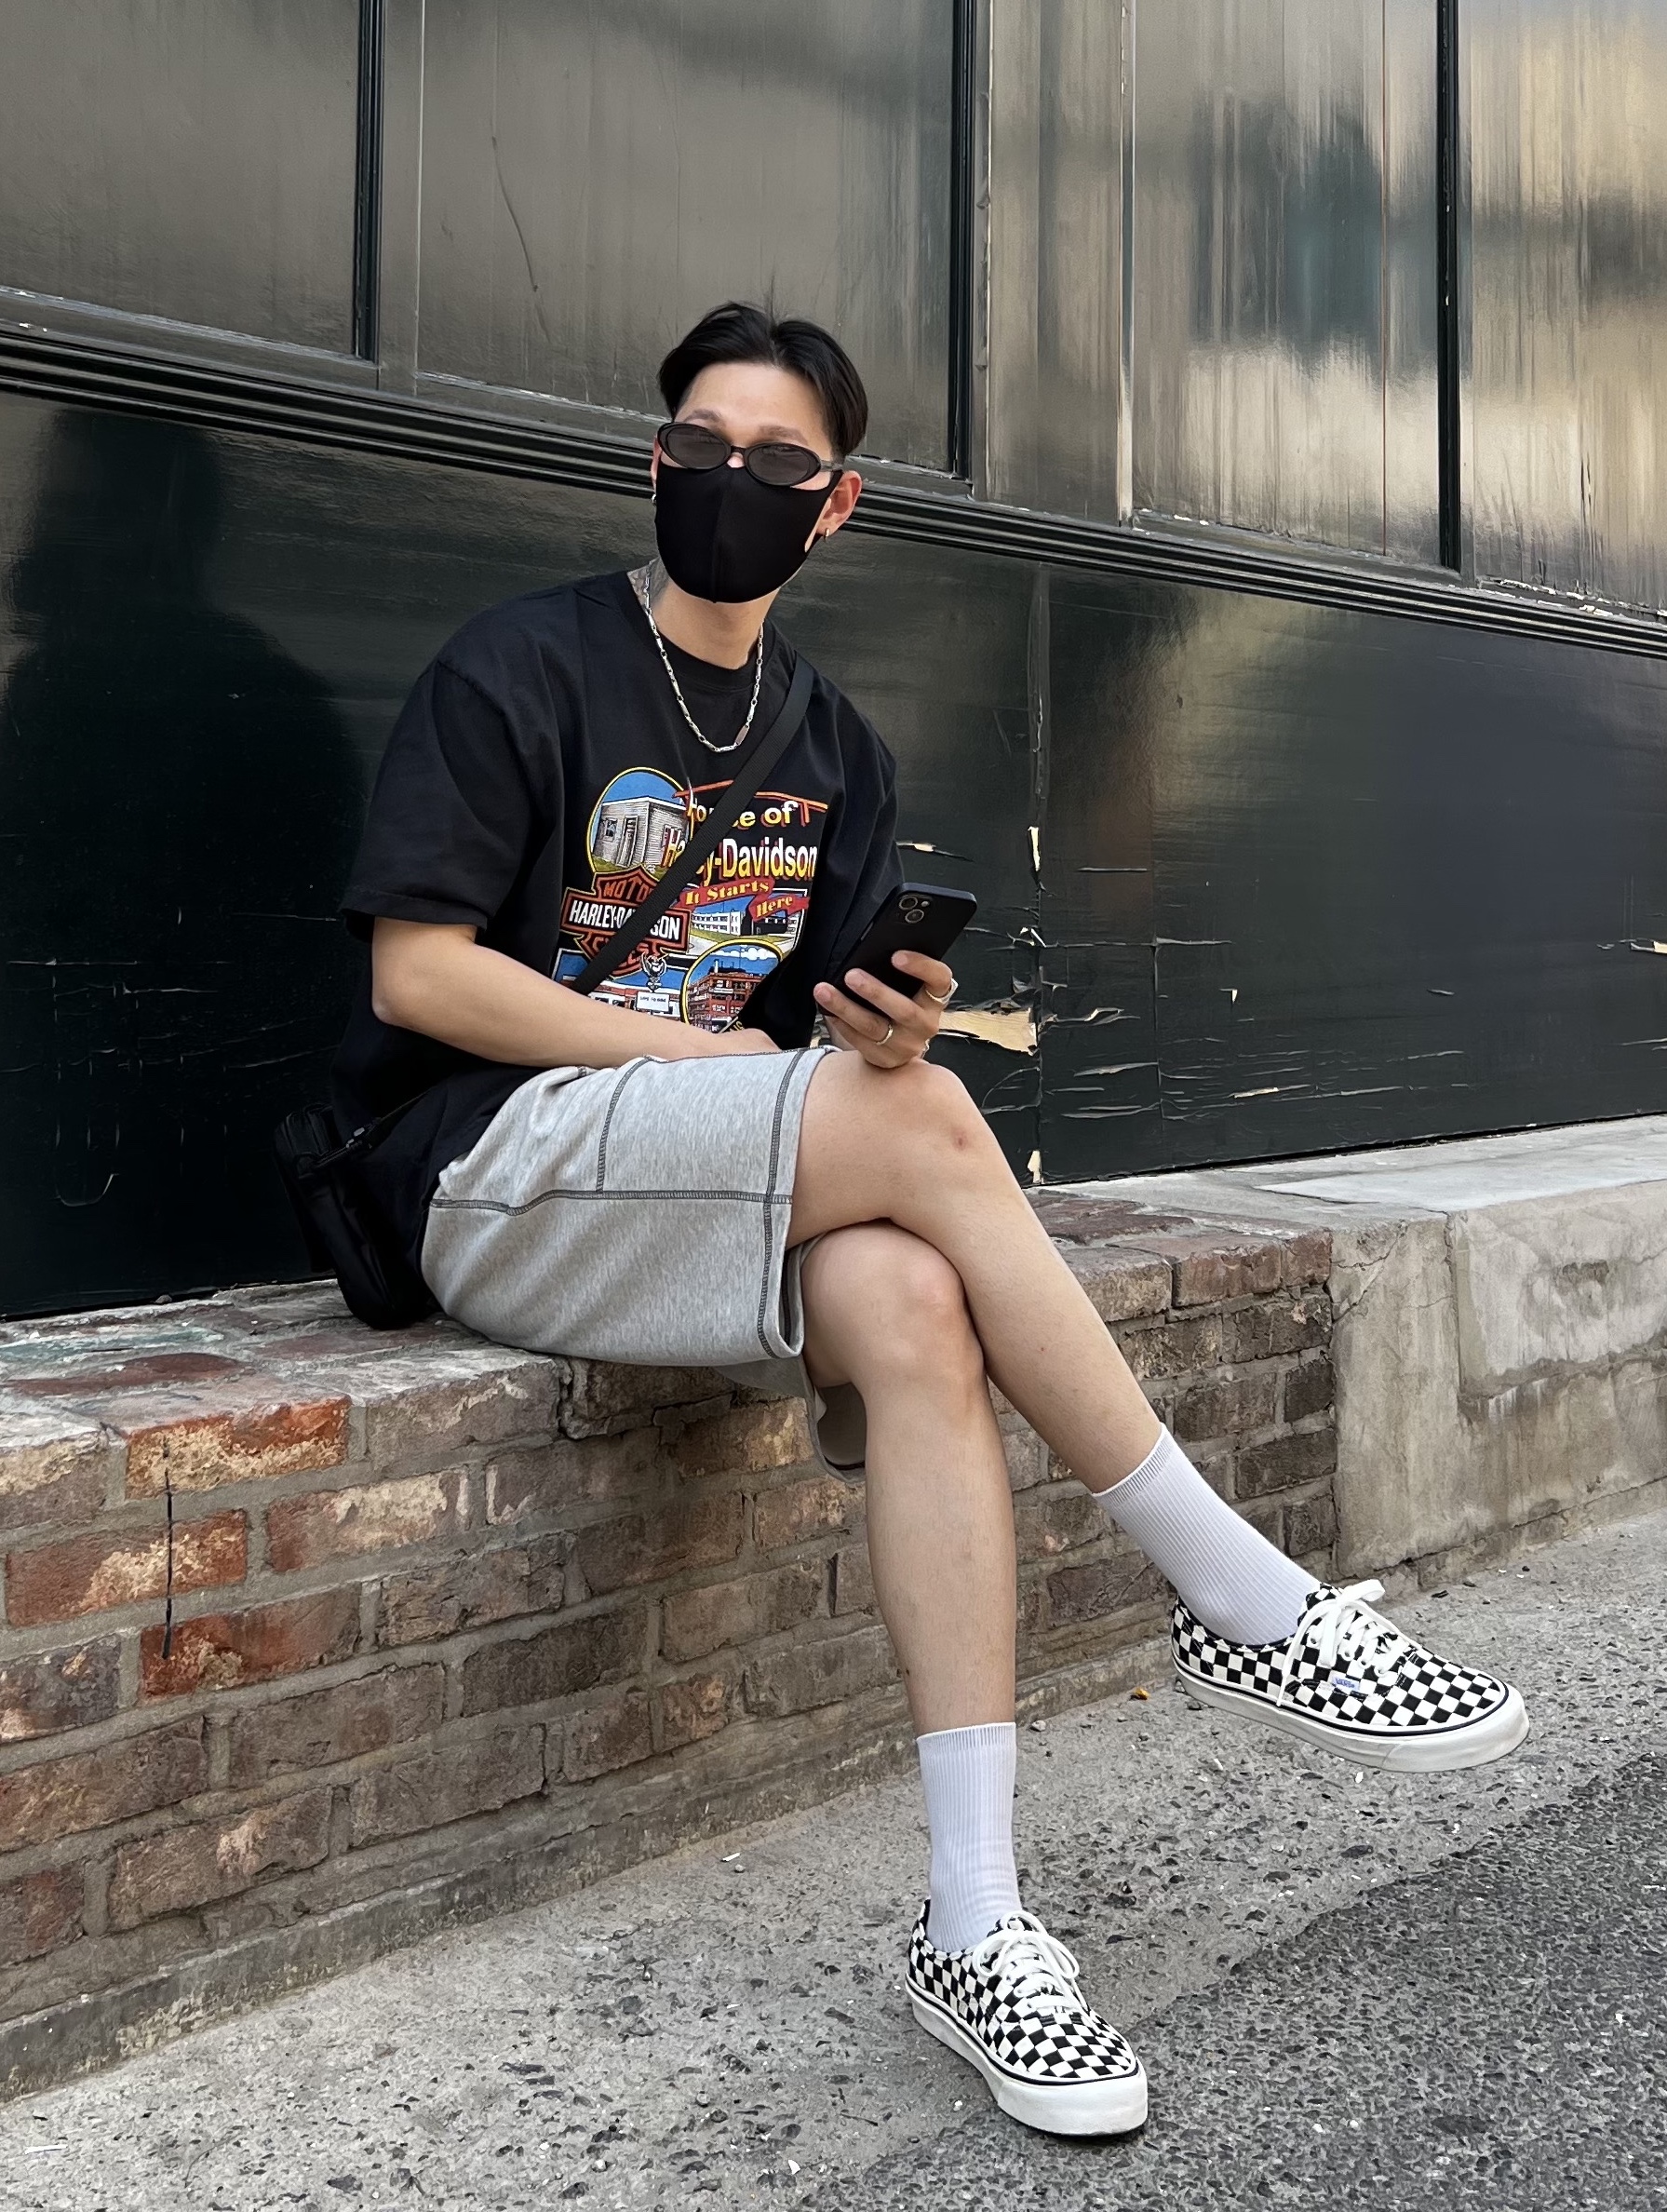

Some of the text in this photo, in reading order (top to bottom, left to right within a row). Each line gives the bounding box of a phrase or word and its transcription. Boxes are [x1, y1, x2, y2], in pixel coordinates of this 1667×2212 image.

[763, 800, 799, 825] of
[603, 877, 655, 903] MOTO
[706, 880, 770, 902] Starts
[756, 896, 793, 918] Here
